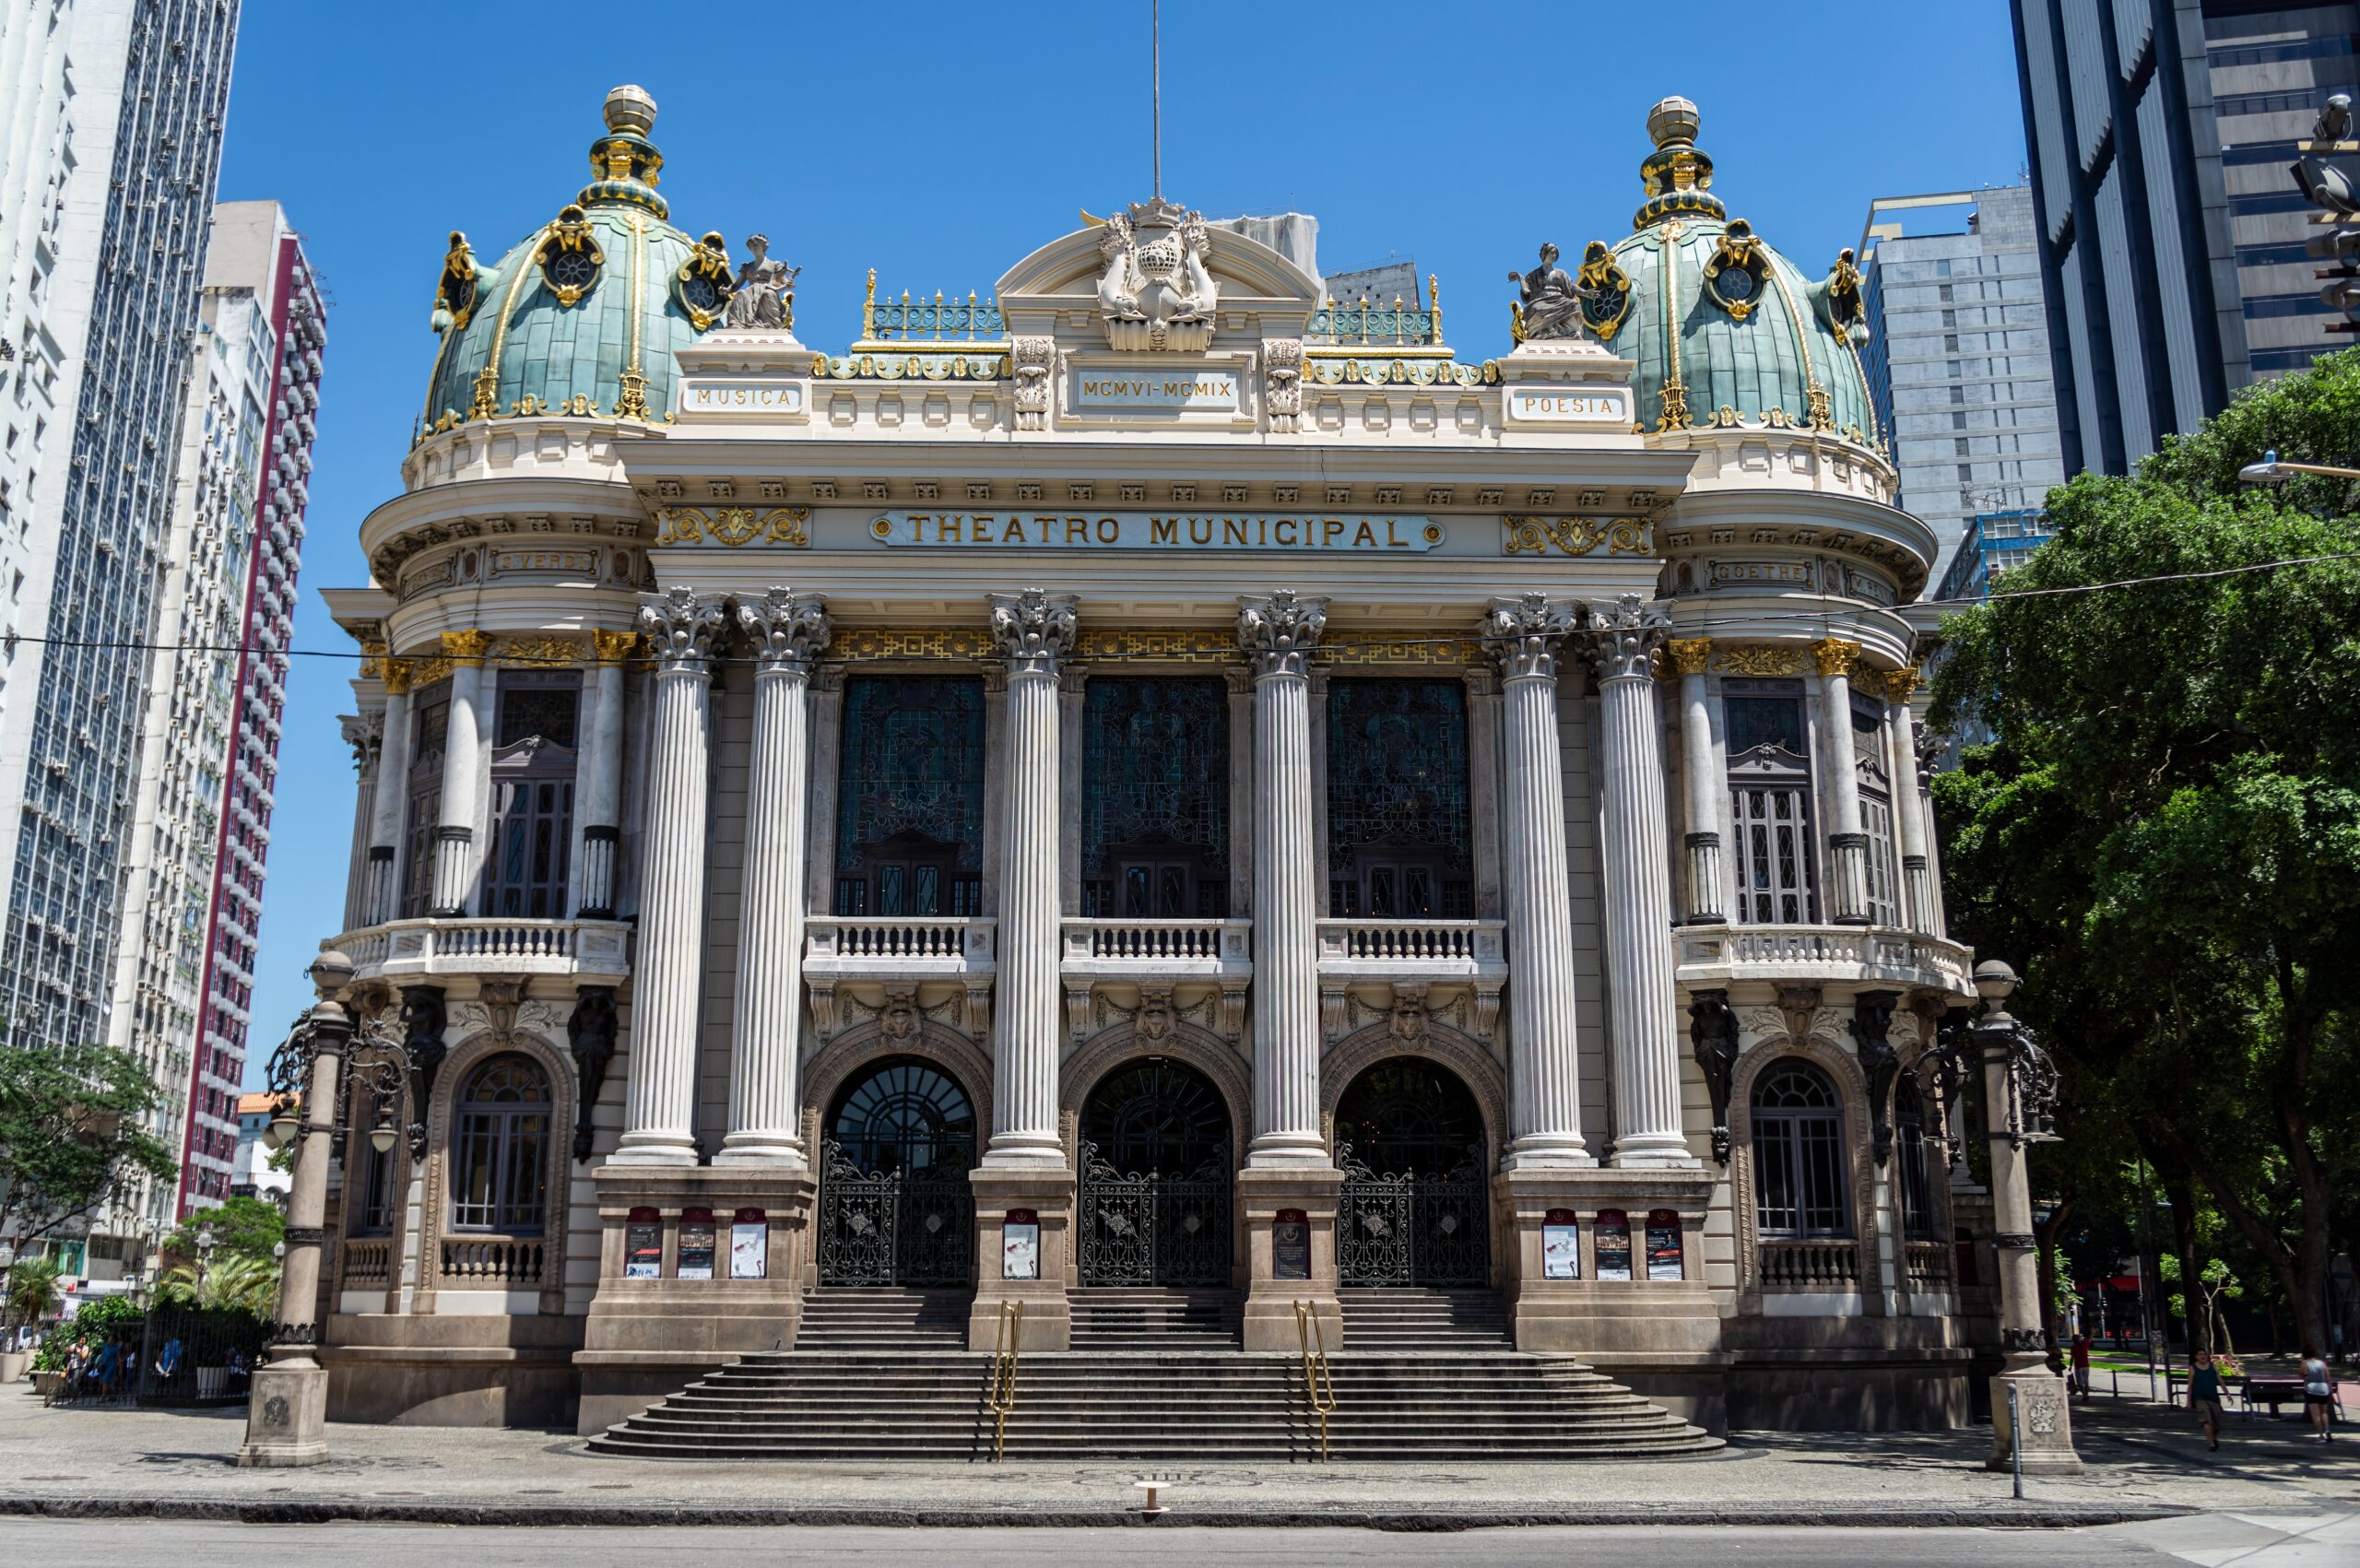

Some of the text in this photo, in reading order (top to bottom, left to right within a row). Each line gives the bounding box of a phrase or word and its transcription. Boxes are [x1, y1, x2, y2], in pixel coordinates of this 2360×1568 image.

[1083, 380, 1232, 397] MCMVI-MCMIX
[697, 390, 791, 406] MUSICA
[1525, 397, 1612, 413] POESIA
[907, 515, 1410, 547] THEATRO MUNICIPAL
[1719, 566, 1802, 580] GOETHE
